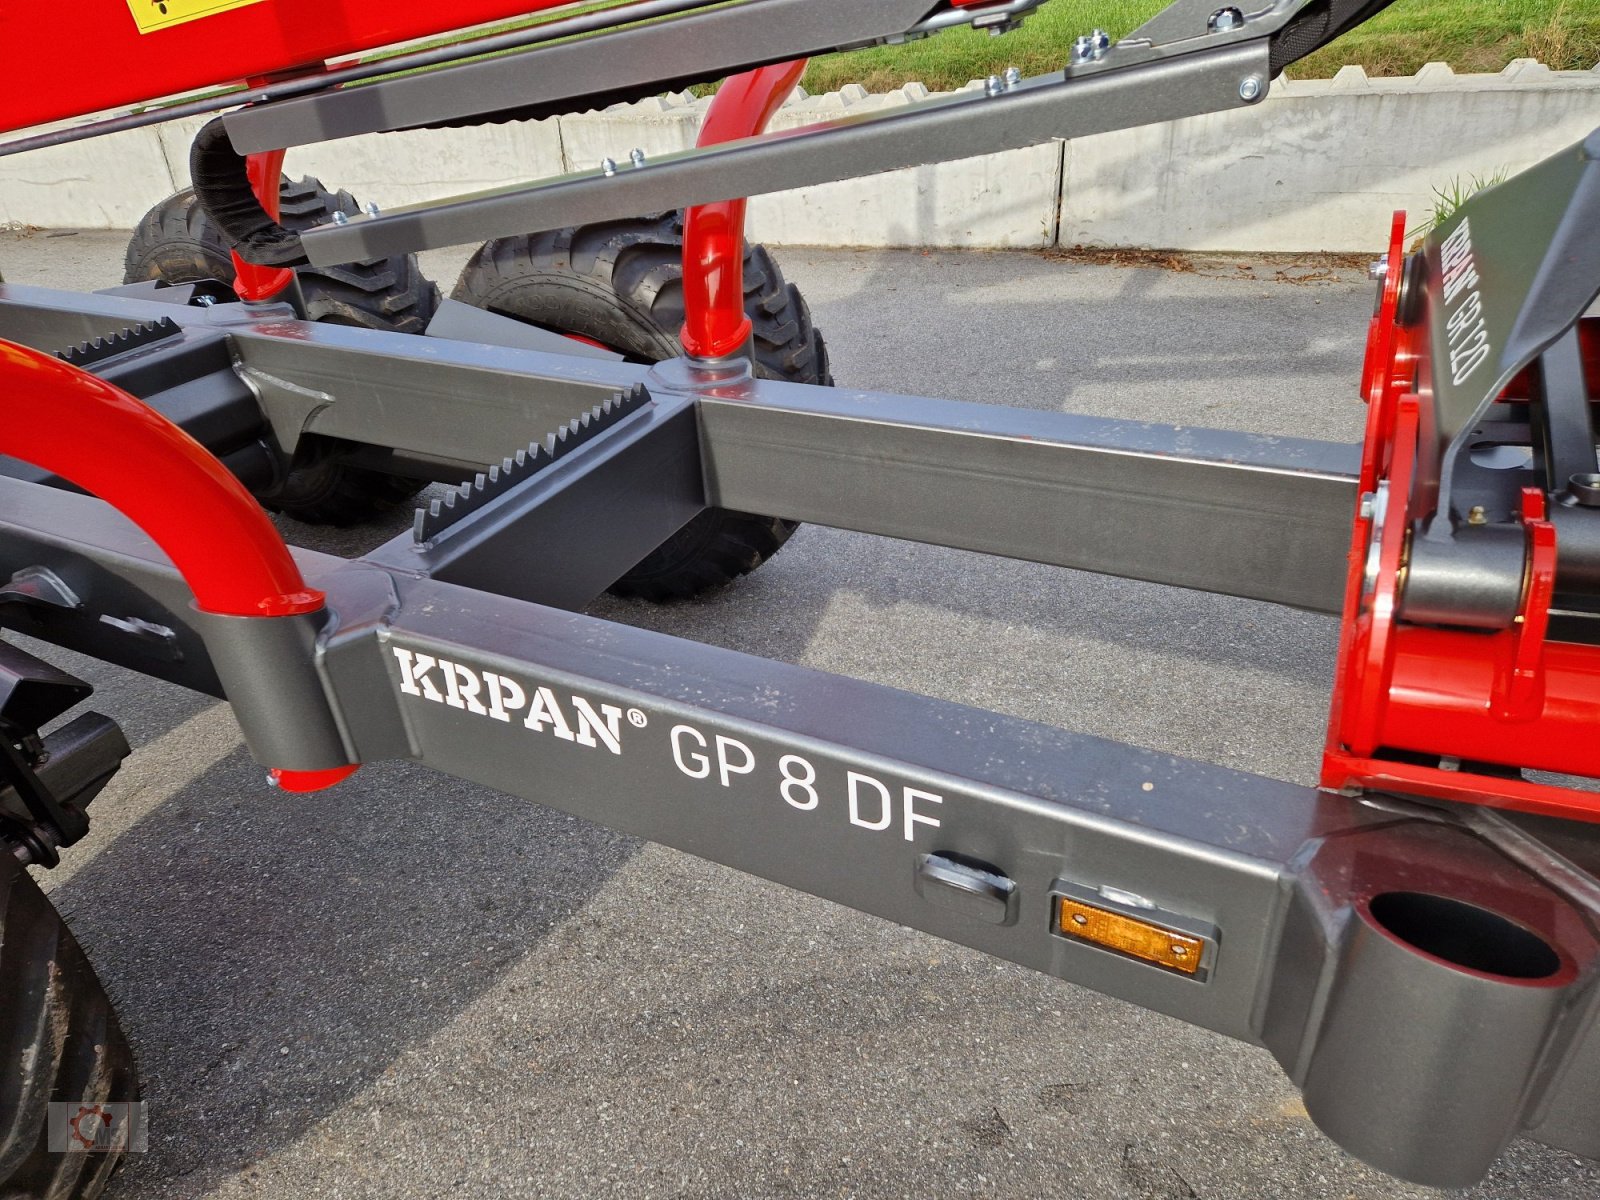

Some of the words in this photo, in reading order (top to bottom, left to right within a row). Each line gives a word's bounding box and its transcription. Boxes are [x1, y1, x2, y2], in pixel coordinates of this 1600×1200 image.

[1447, 290, 1482, 346] GR
[1450, 318, 1490, 386] 120
[670, 724, 755, 787] GP
[778, 754, 819, 811] 8
[847, 770, 943, 842] DF
